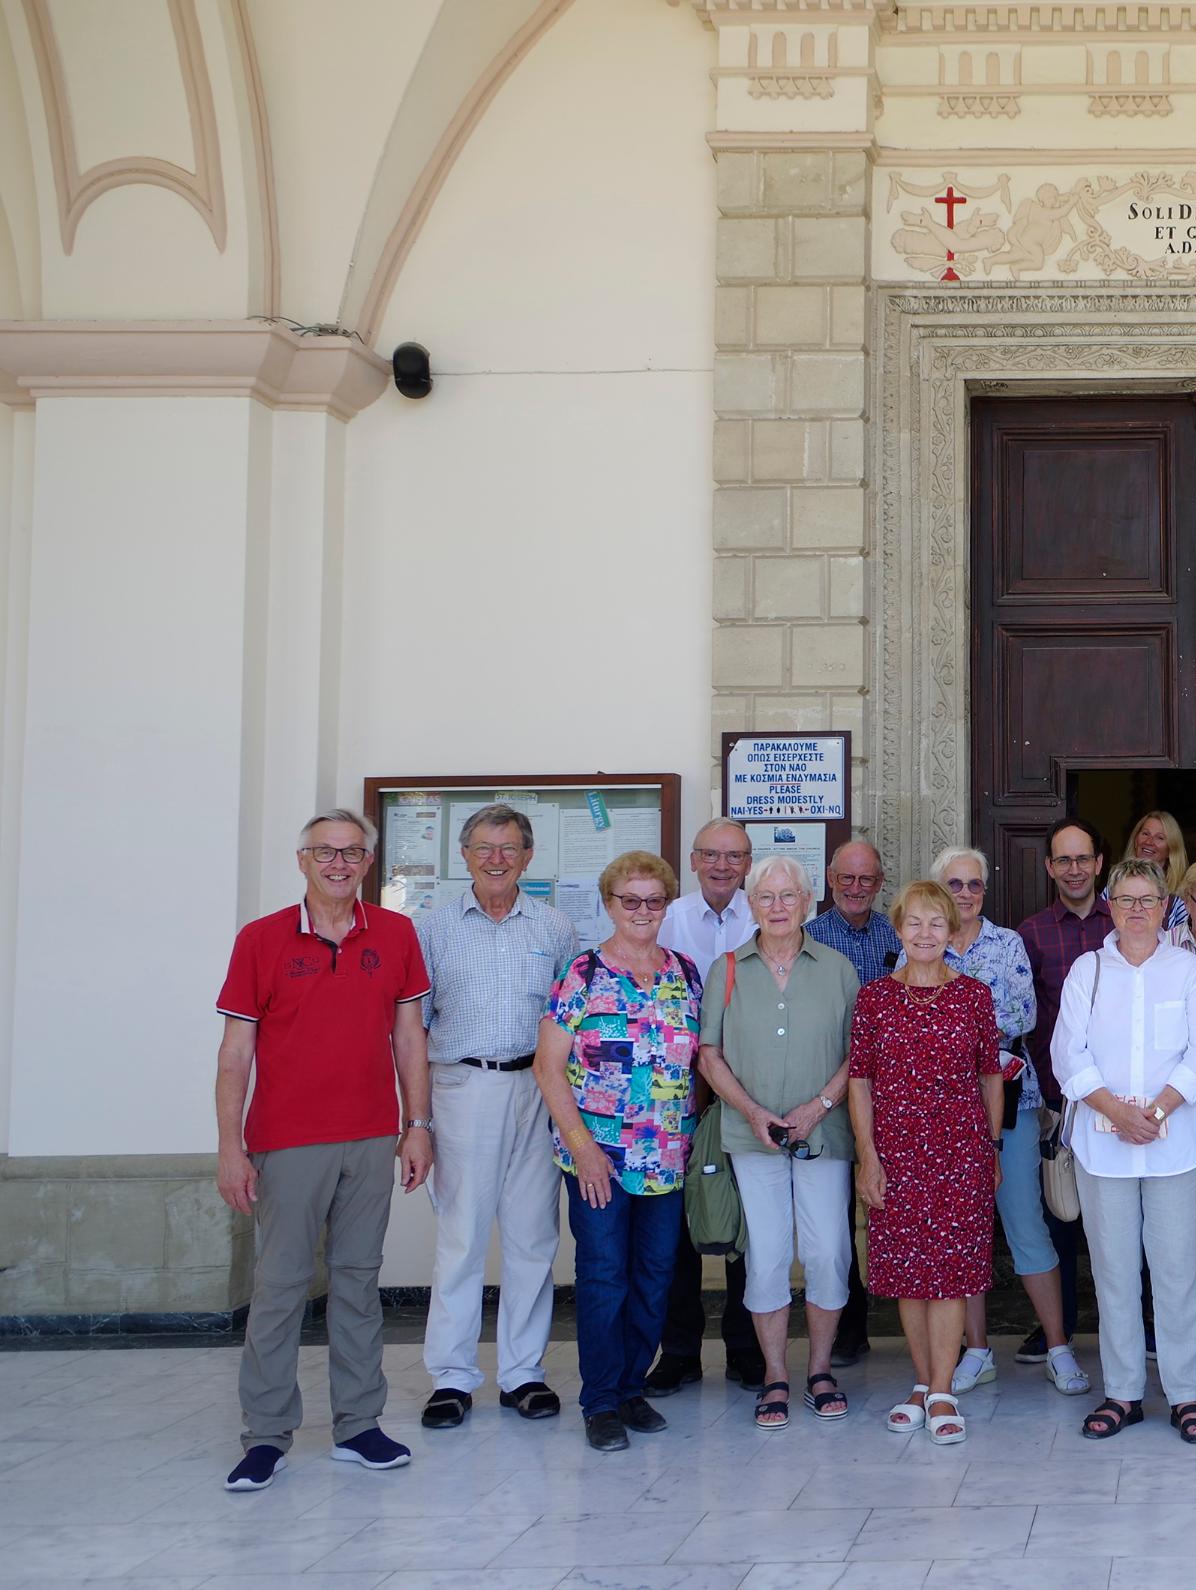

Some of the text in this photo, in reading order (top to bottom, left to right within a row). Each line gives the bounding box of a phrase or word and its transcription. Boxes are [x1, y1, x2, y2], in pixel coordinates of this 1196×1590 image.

[1128, 203, 1173, 220] SOLI
[1154, 226, 1177, 240] ET
[753, 743, 818, 752] ΠΑΡΑΚΑΛΟΥΜΕ
[747, 753, 824, 763] ΟΠΩΣ ΕΙΣΕΡΧΕΣΤΕ
[764, 763, 807, 773] ΣΤΟΝ ΝΑΟ
[735, 773, 837, 783] ΜΕ ΚΟΣΜΙΑ ΕΝΔΥΜΑΣΙΑ
[769, 785, 801, 794] PLEASE
[746, 795, 824, 805] DRESS MODESTLY
